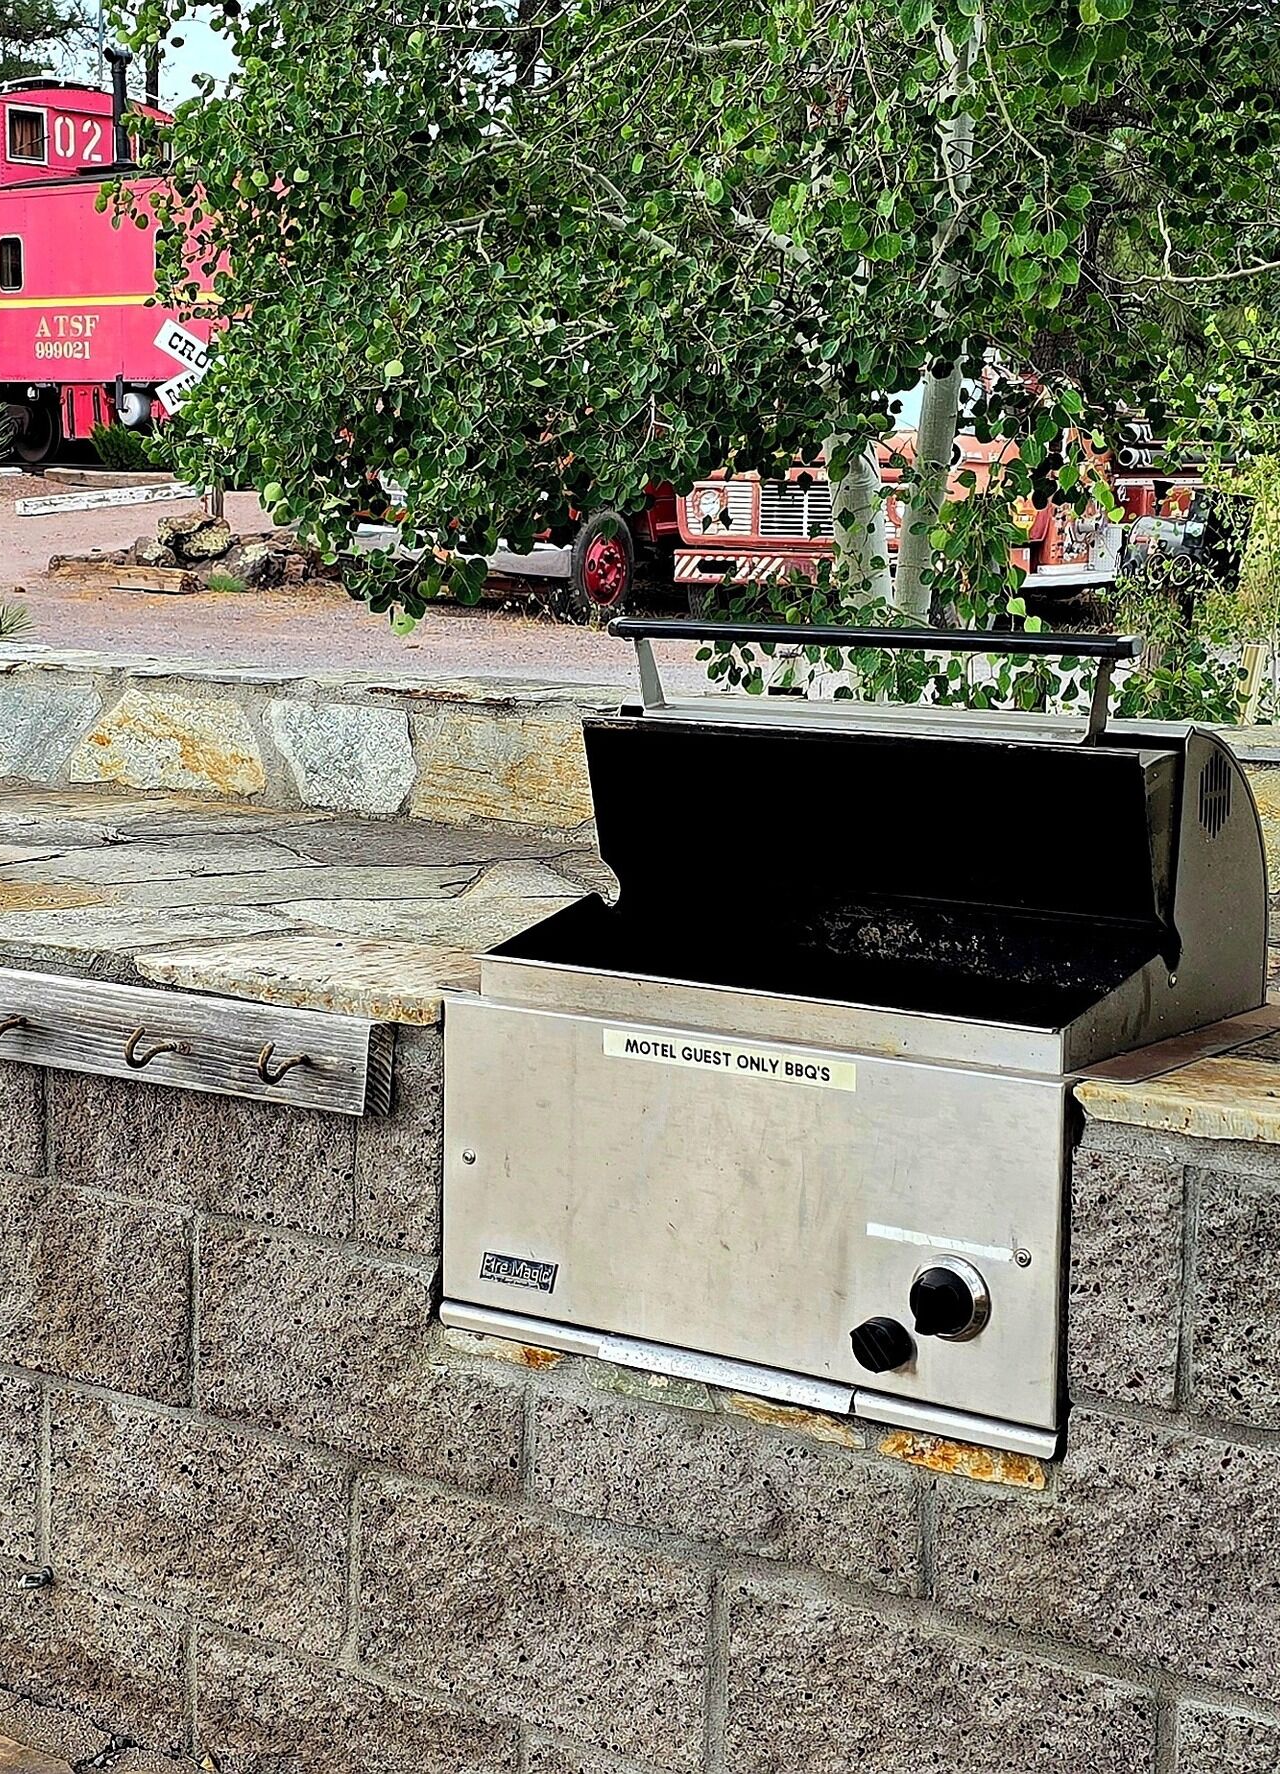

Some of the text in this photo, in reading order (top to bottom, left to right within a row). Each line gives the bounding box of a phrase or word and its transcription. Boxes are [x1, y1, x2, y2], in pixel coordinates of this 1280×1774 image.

[54, 115, 102, 162] 02
[34, 314, 100, 338] ATSF
[34, 340, 91, 360] 999021
[624, 1038, 831, 1082] MOTEL GUEST ONLY BBQ'S
